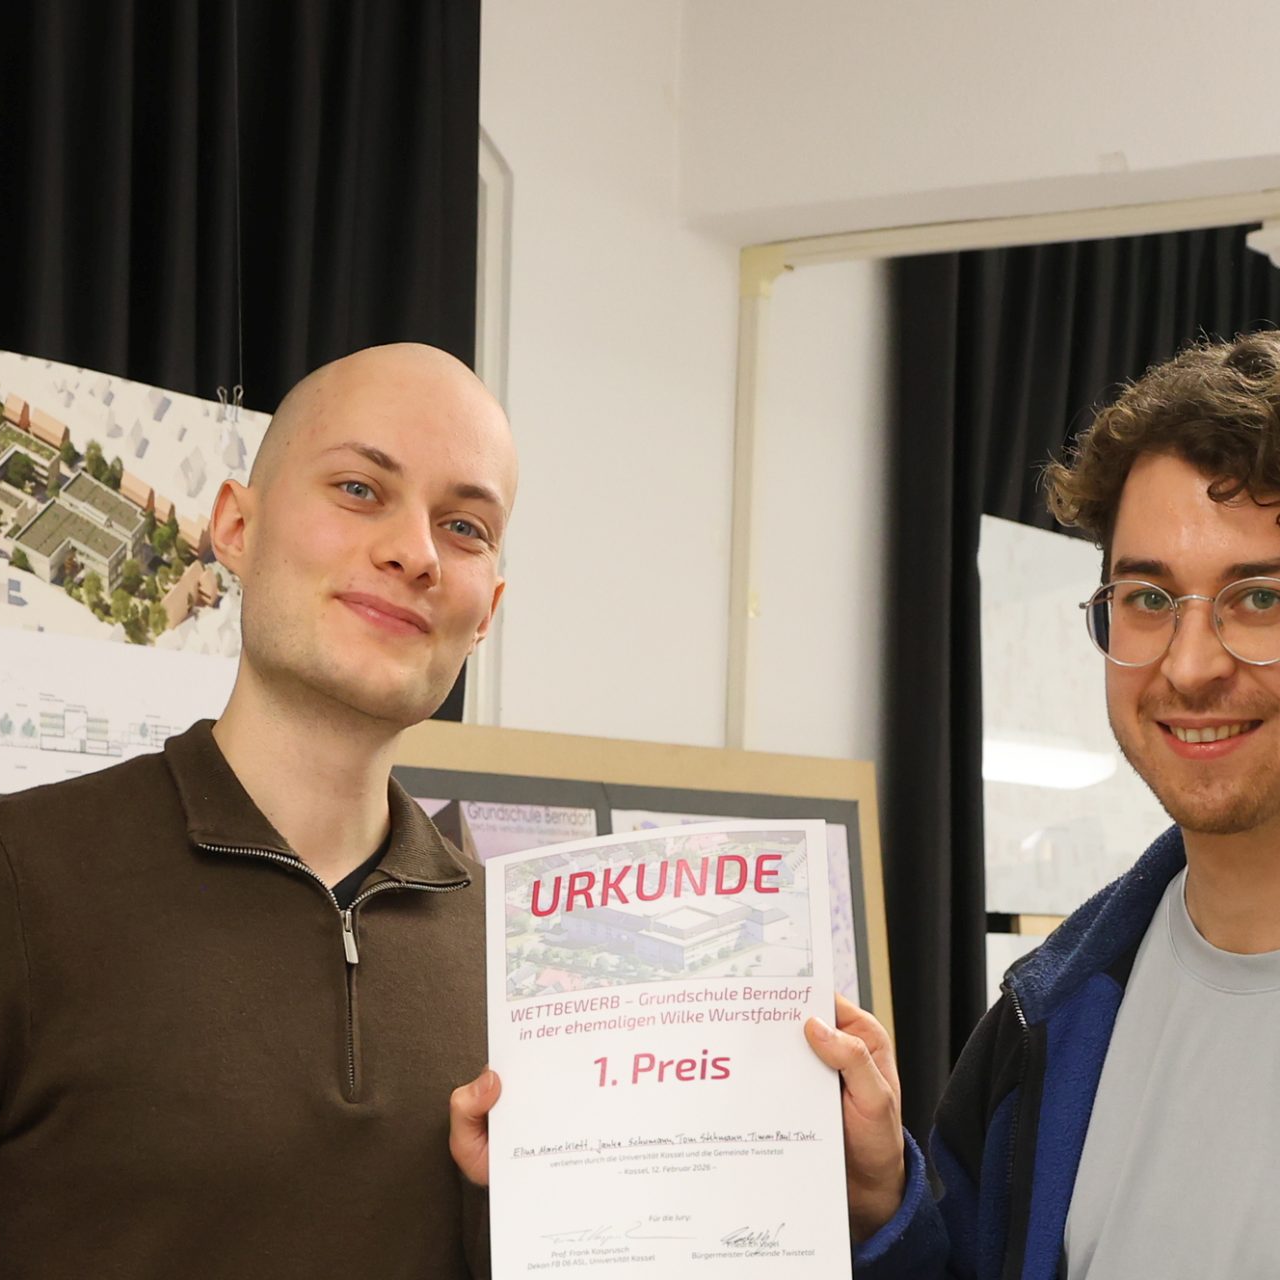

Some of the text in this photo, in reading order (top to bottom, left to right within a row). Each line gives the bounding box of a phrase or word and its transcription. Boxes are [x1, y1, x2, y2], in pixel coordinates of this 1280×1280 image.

[467, 800, 542, 822] Grundschule
[529, 853, 783, 918] URKUNDE
[510, 995, 621, 1023] WETTBEWERB
[638, 987, 739, 1006] Grundschule
[742, 985, 813, 1004] Berndorf
[519, 1007, 803, 1041] in der ehemaligen Wilke Wurstfabrik
[592, 1048, 732, 1088] 1. Preis
